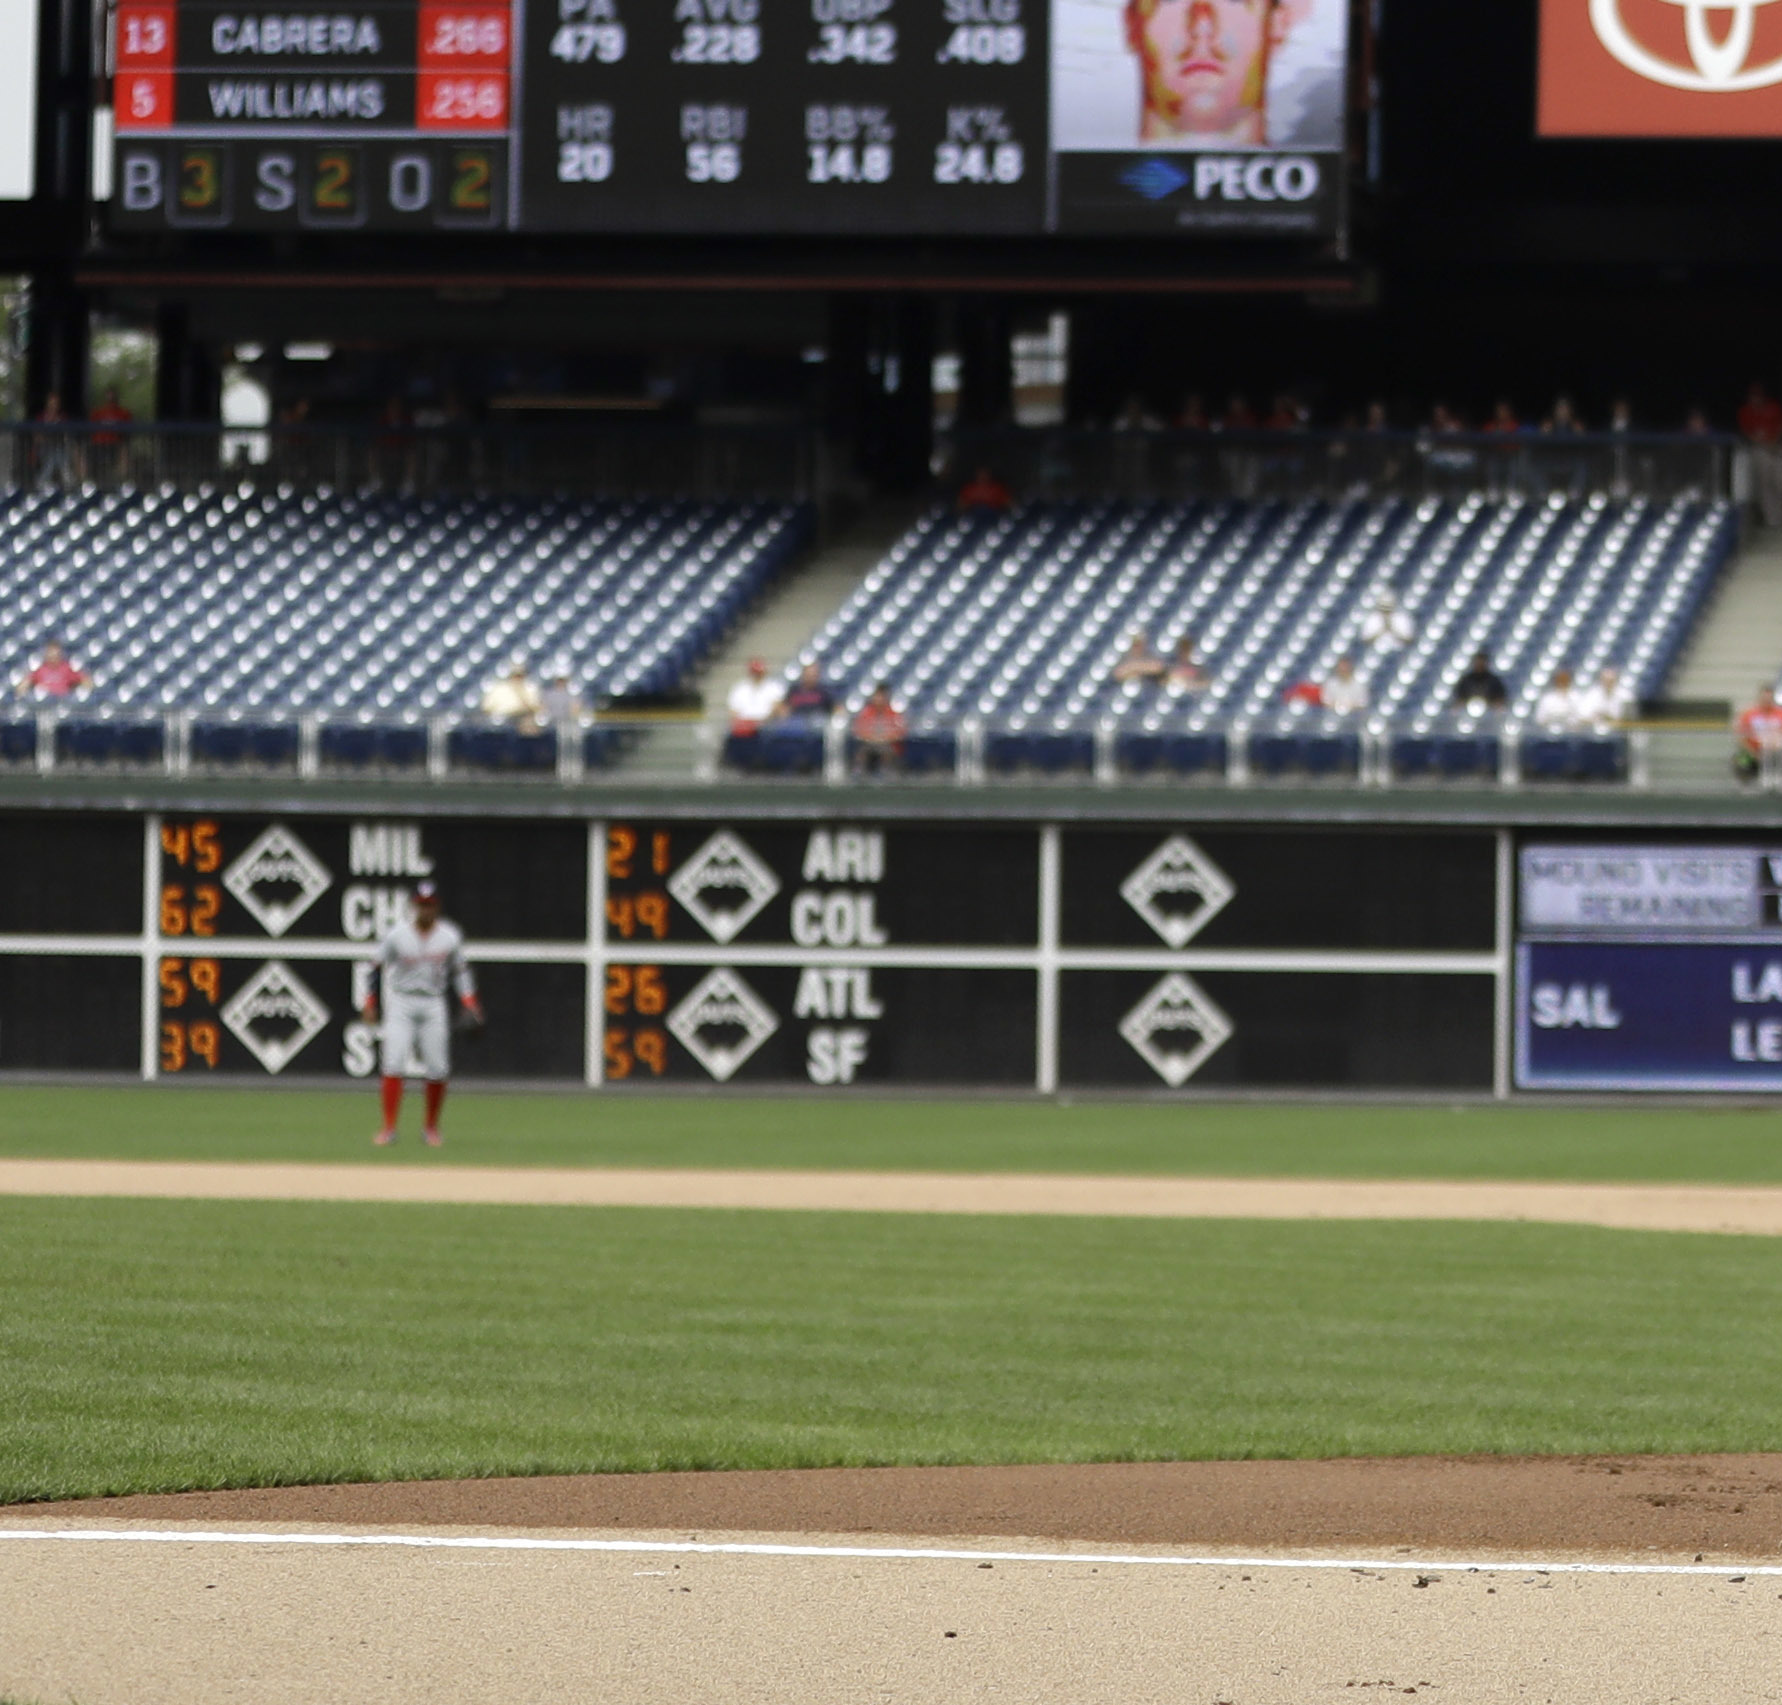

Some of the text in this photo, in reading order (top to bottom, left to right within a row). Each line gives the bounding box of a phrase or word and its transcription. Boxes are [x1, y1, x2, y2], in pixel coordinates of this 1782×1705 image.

[125, 17, 166, 54] 13
[212, 14, 381, 54] CABRERA
[551, 23, 626, 63] 479
[670, 23, 761, 63] .228
[806, 23, 897, 64] .342
[209, 80, 385, 118] WILLIAMS
[556, 104, 613, 142] HR
[680, 104, 748, 142] RBI
[124, 156, 162, 210] B
[182, 157, 214, 208] 3
[255, 156, 296, 211] S
[315, 157, 350, 208] 2
[454, 158, 490, 208] 2
[556, 142, 614, 183] 20
[685, 142, 741, 183] 56
[1194, 157, 1319, 200] PECO
[161, 821, 434, 877] 45 MIL
[607, 825, 885, 883] 21 ARI
[159, 884, 220, 937] 62
[605, 893, 888, 947] 49 COL
[159, 957, 220, 1008] 59
[604, 963, 884, 1019] 26 ATL
[1531, 984, 1620, 1029] SAL
[160, 1020, 220, 1072] 39
[603, 1027, 869, 1085] 59 SF
